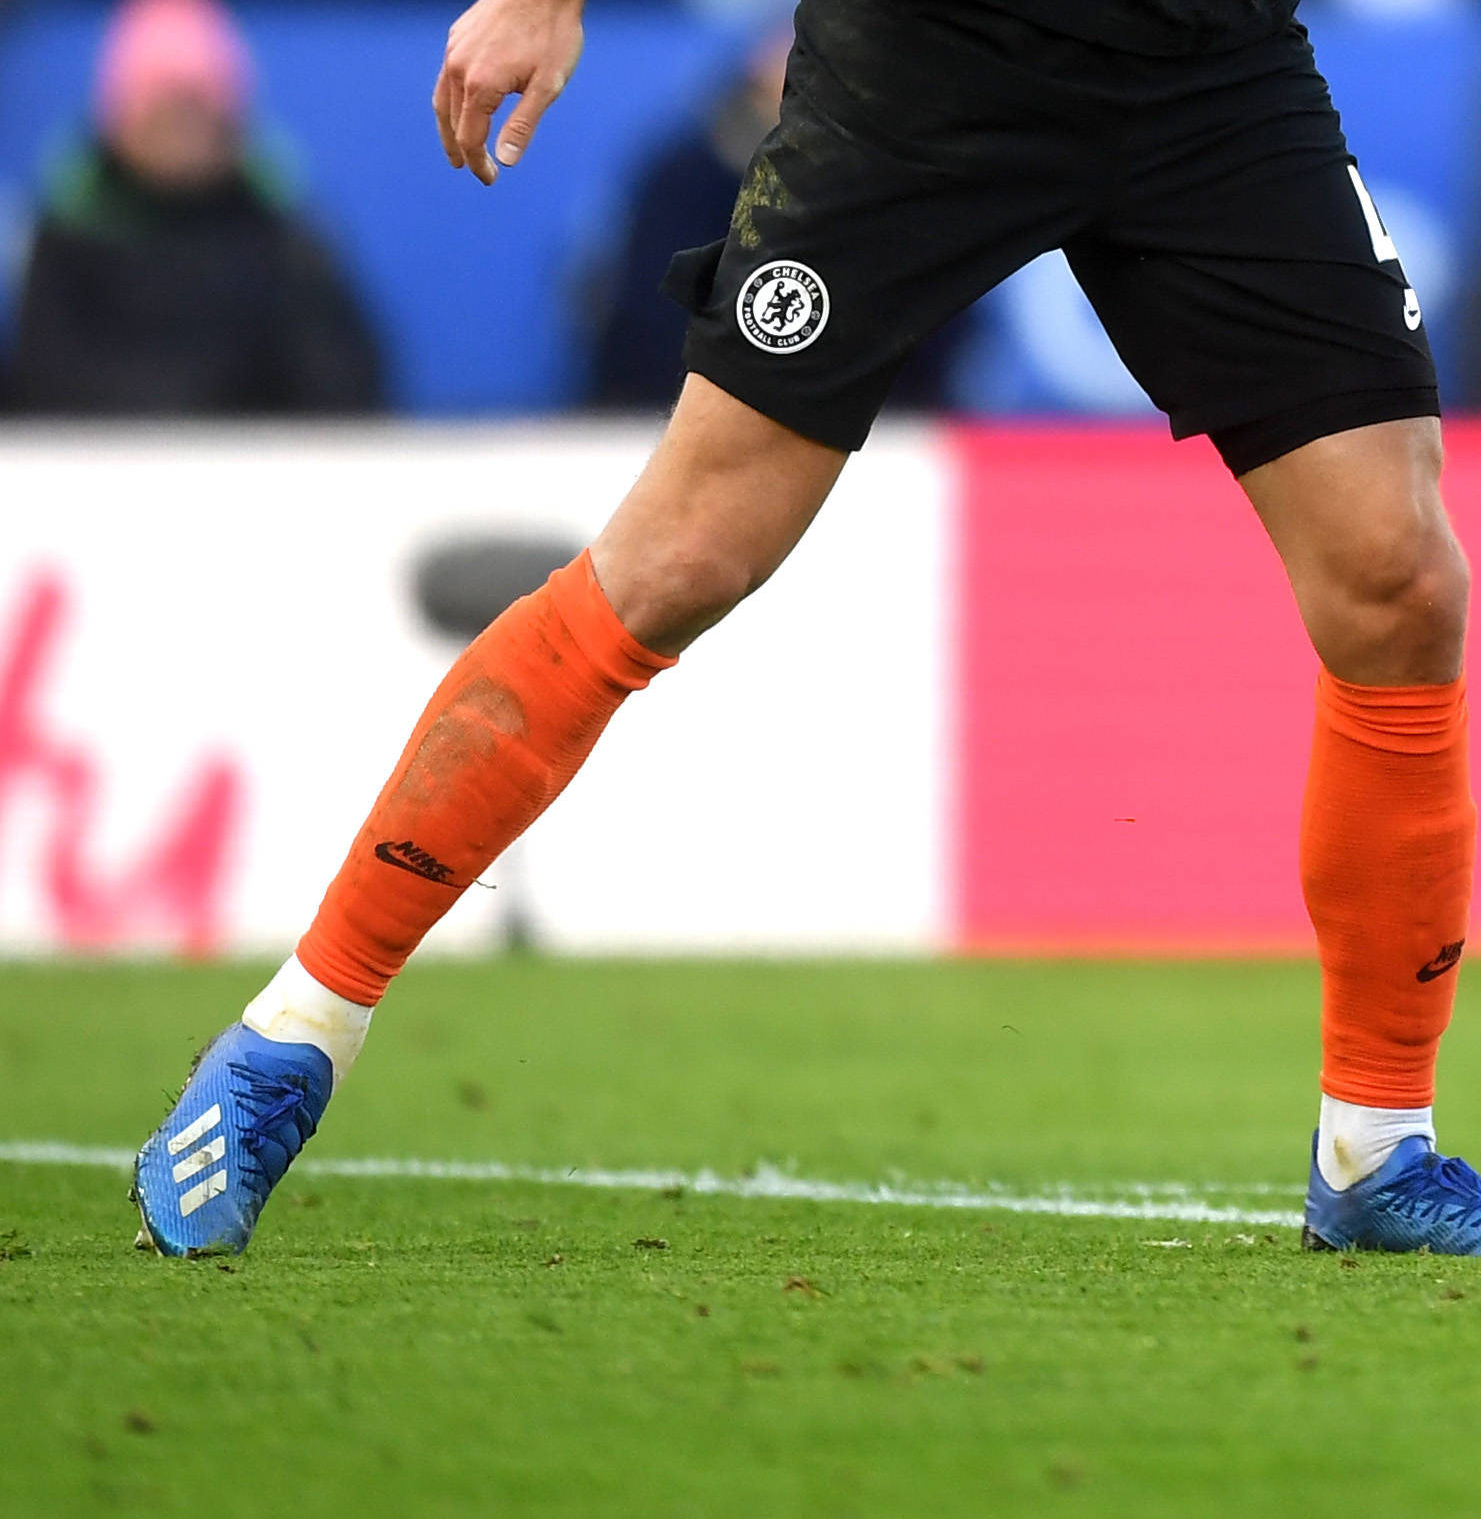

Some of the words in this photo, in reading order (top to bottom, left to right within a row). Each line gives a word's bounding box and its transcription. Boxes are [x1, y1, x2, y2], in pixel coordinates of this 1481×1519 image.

[772, 267, 820, 301] CHELSEA
[743, 306, 772, 346] FOOTBALL
[777, 335, 801, 347] CLUB
[394, 840, 456, 880] NIKE
